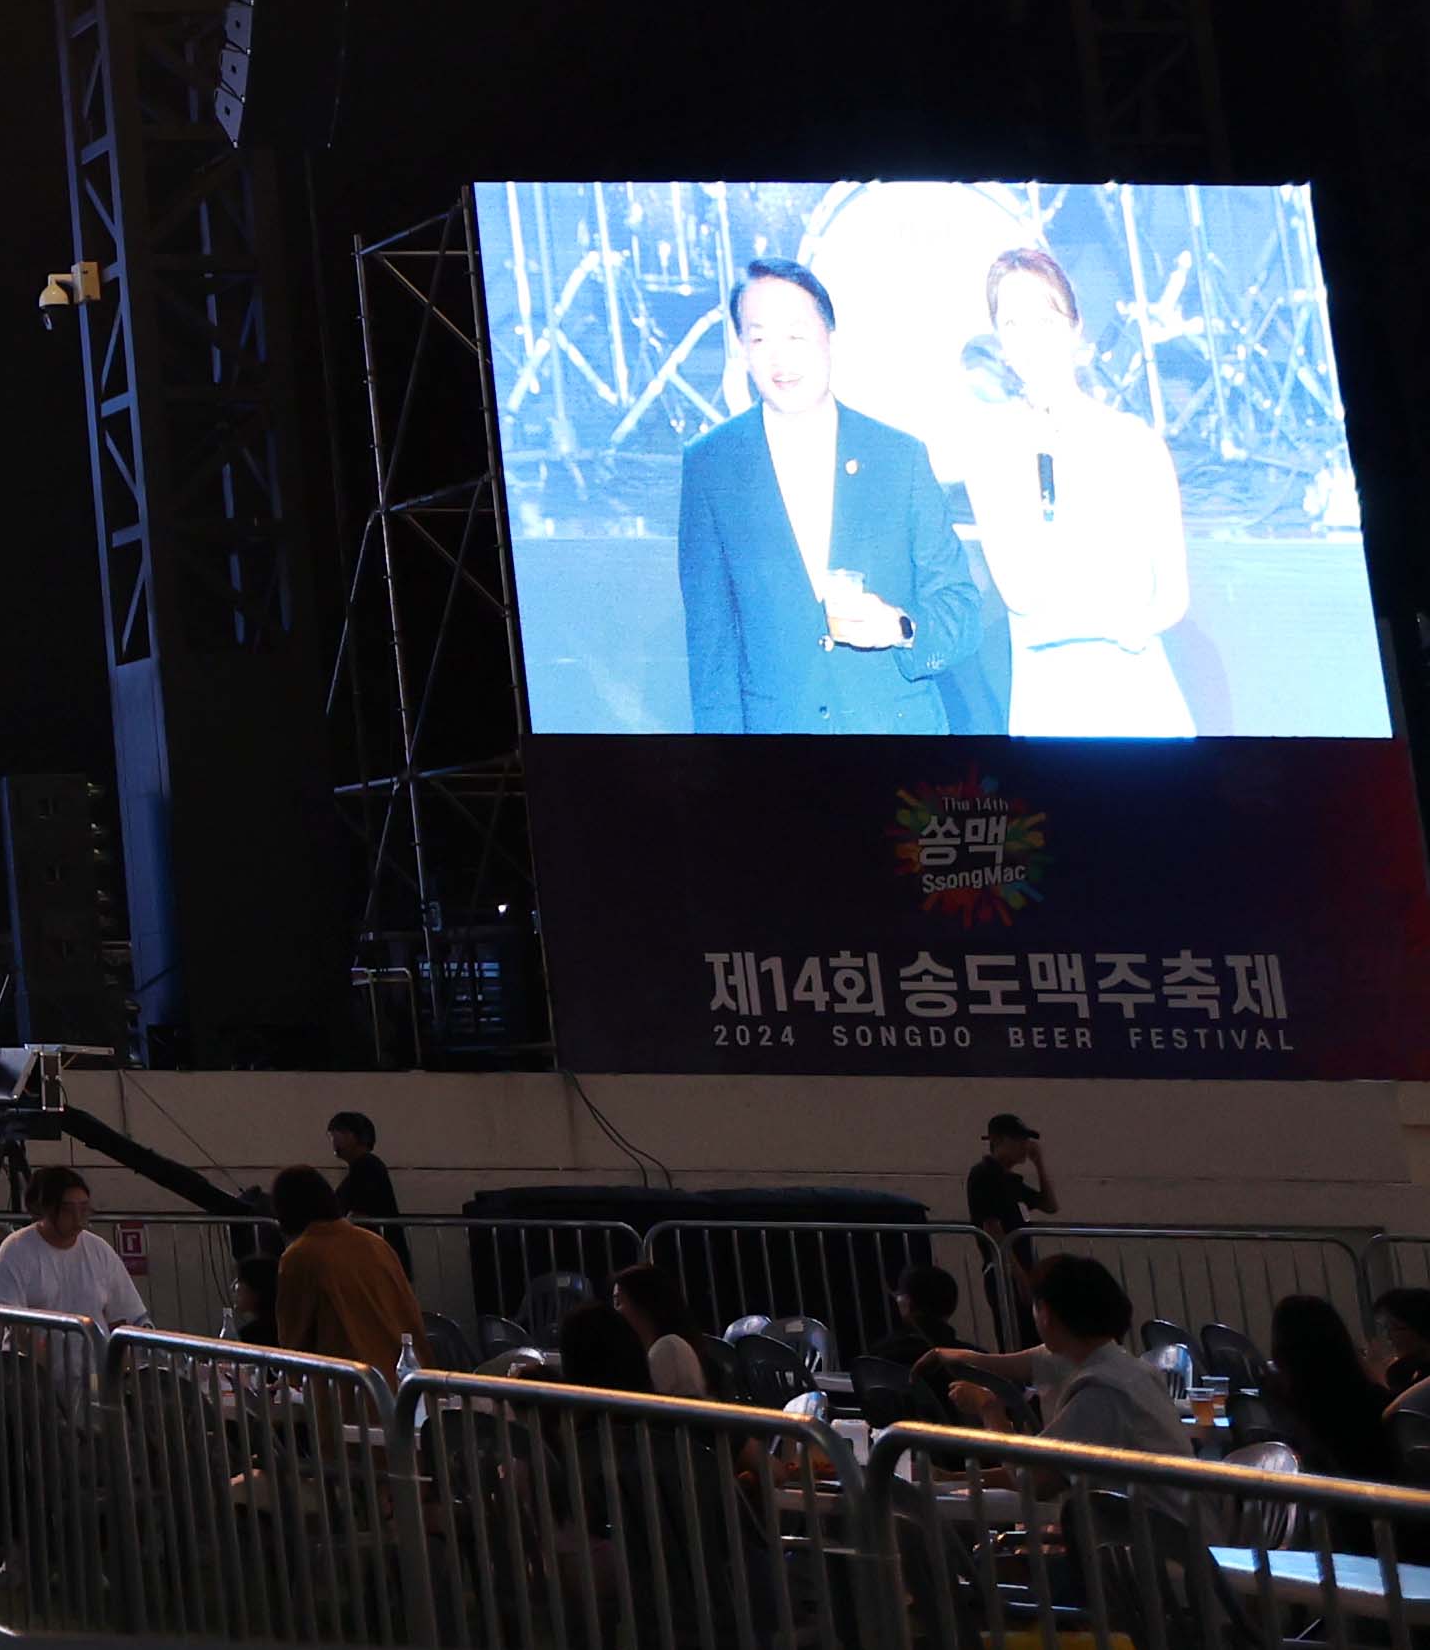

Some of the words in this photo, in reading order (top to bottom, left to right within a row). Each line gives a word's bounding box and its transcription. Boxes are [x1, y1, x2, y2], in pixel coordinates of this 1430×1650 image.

[917, 813, 1008, 866] 쏭맥
[921, 863, 1027, 894] SsongMac
[703, 950, 887, 1017] 제14회
[898, 949, 1289, 1019] 송도맥주축제
[712, 1024, 796, 1047] 2024
[831, 1024, 972, 1047] SONGDO
[1008, 1026, 1094, 1049] BEER
[1128, 1027, 1295, 1051] FESTIVAL
